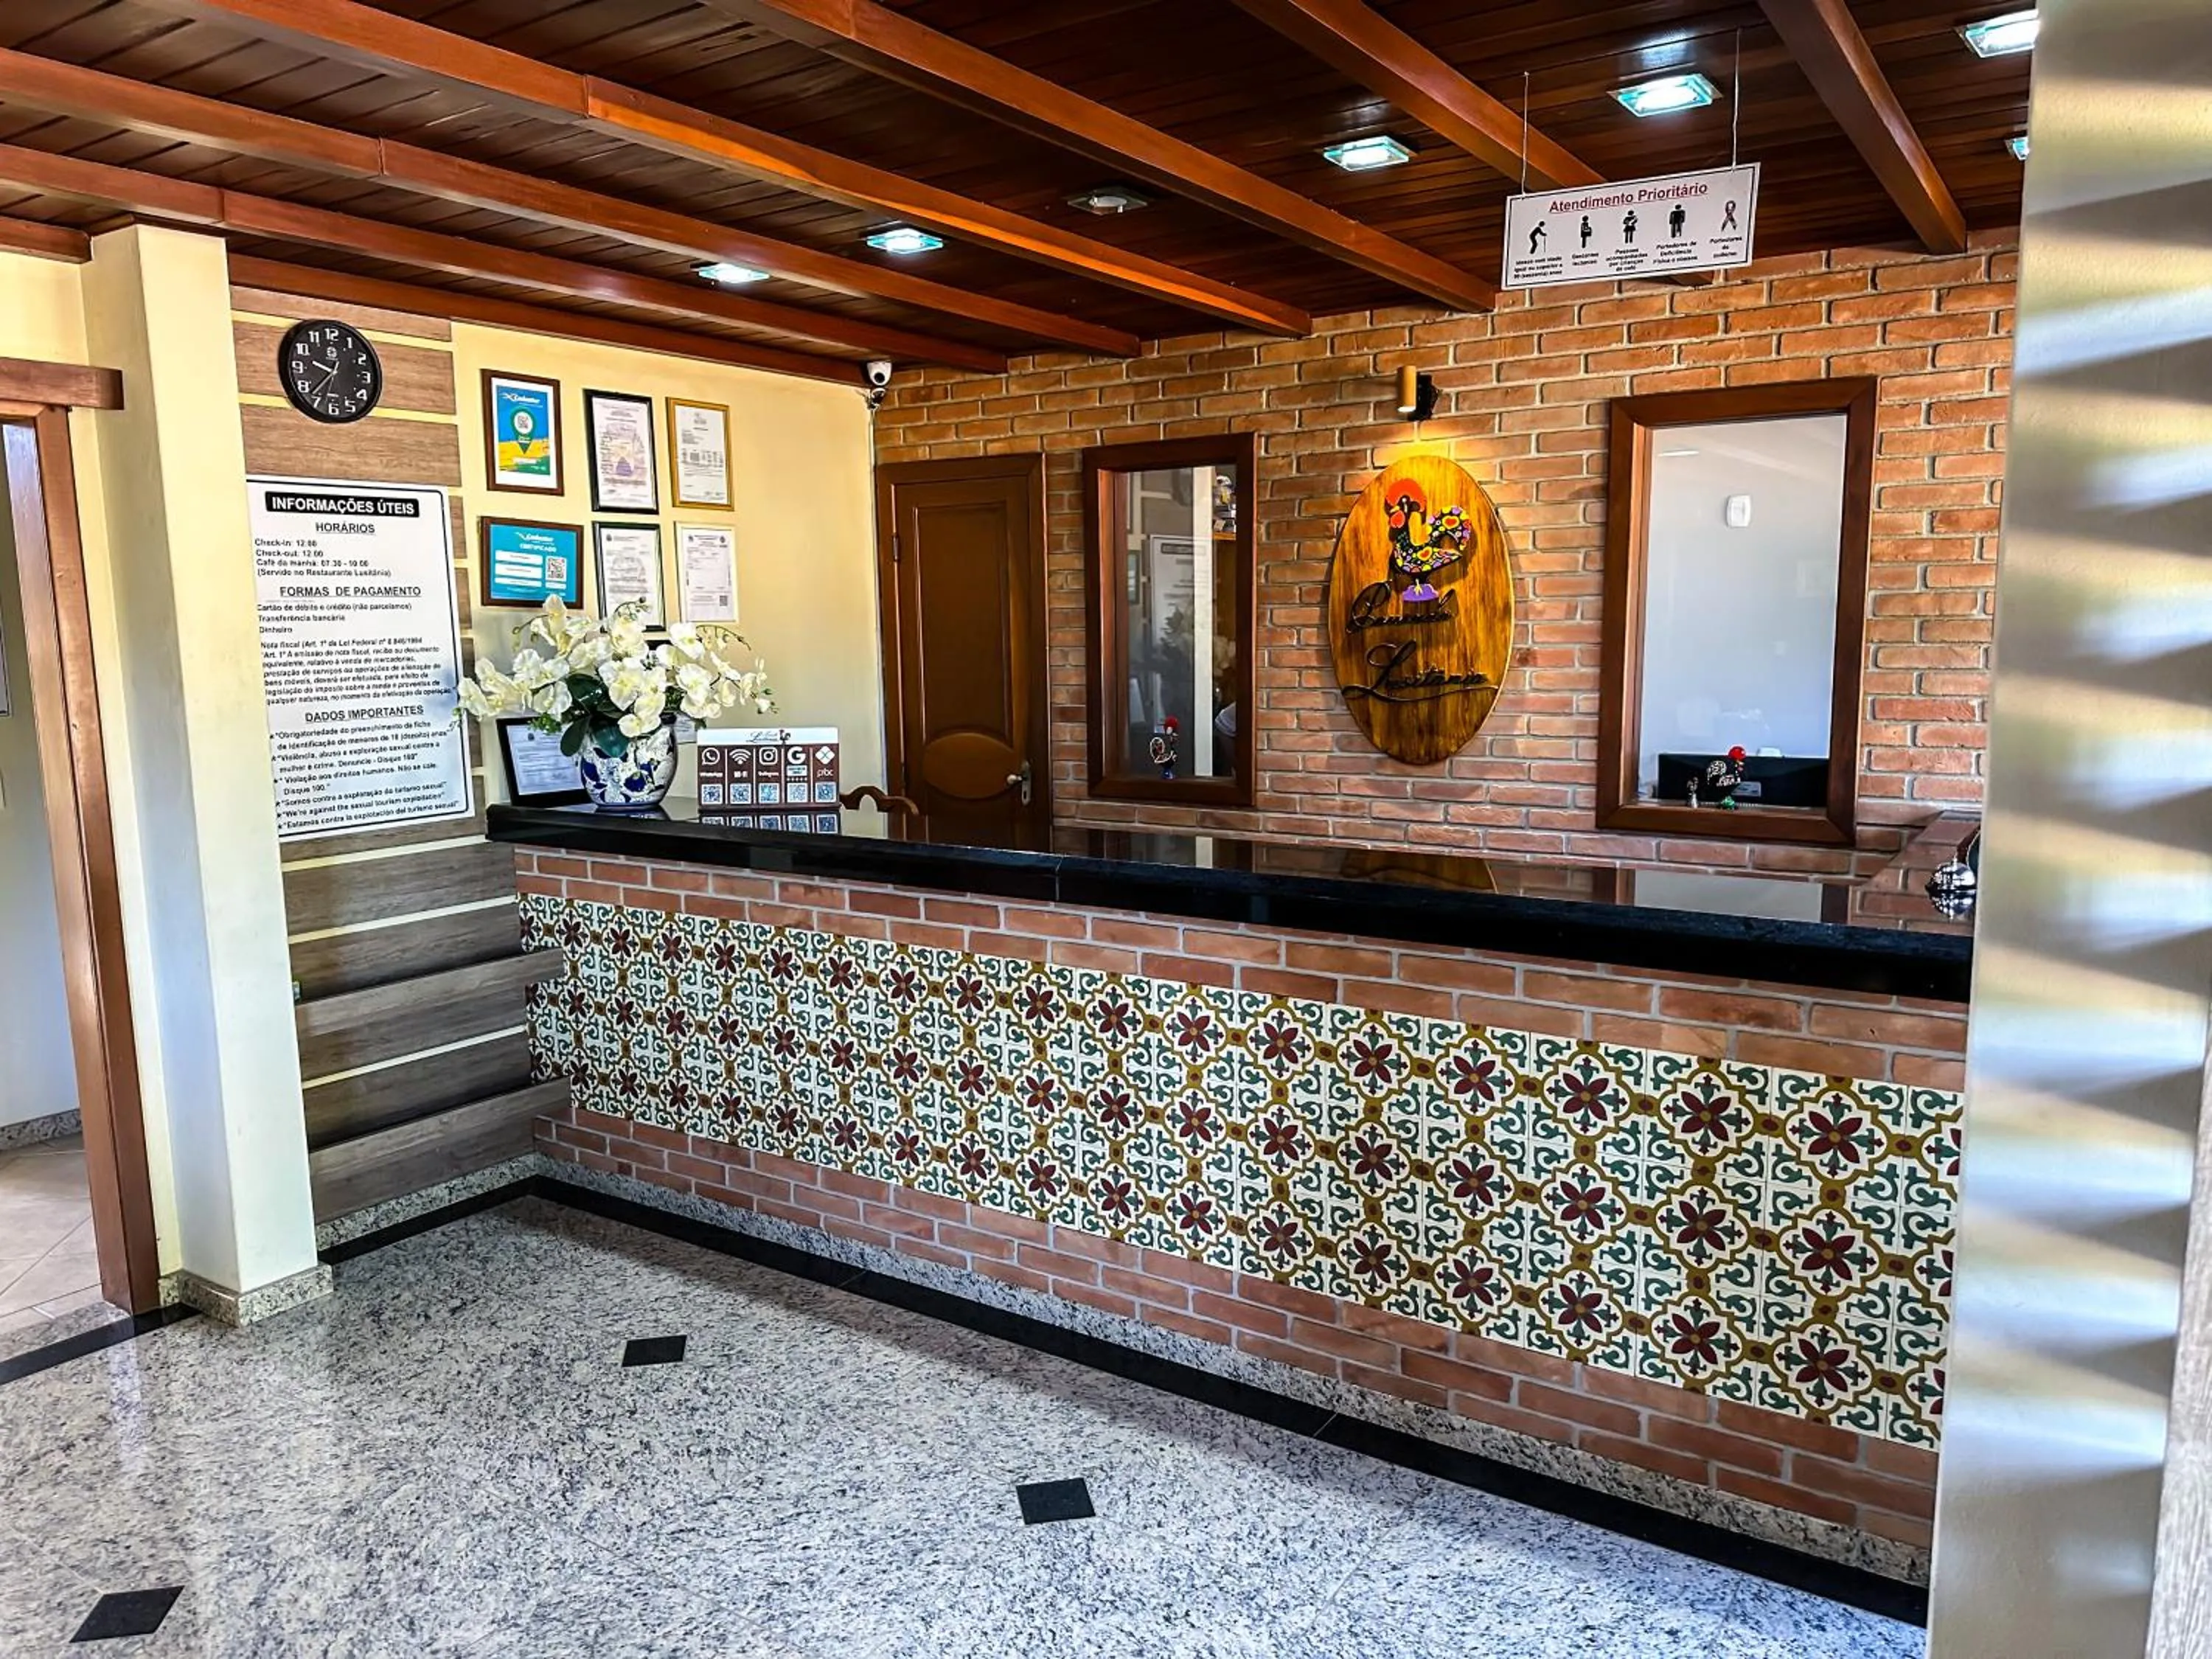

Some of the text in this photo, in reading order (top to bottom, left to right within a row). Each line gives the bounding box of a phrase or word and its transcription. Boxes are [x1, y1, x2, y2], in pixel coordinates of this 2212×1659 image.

[1548, 182, 1708, 214] Atendimento Prioritário
[308, 331, 320, 343] 11
[324, 328, 339, 341] 12
[296, 343, 310, 355] 10
[347, 337, 352, 349] 1
[358, 352, 366, 366] 2
[292, 361, 303, 374] 9
[361, 371, 371, 383] 3
[297, 380, 309, 393] 8
[356, 389, 367, 400] 4
[311, 396, 321, 408] 7
[344, 400, 355, 413] 5
[328, 403, 339, 415] 6
[272, 496, 414, 515] INFORMAÇÕES ÚTEIS
[316, 521, 375, 533] HORÁRIOS
[279, 586, 421, 597] FORMAS DE PAGAMENTO
[305, 704, 424, 722] DADOS IMPORTANTES
[787, 745, 806, 765] G
